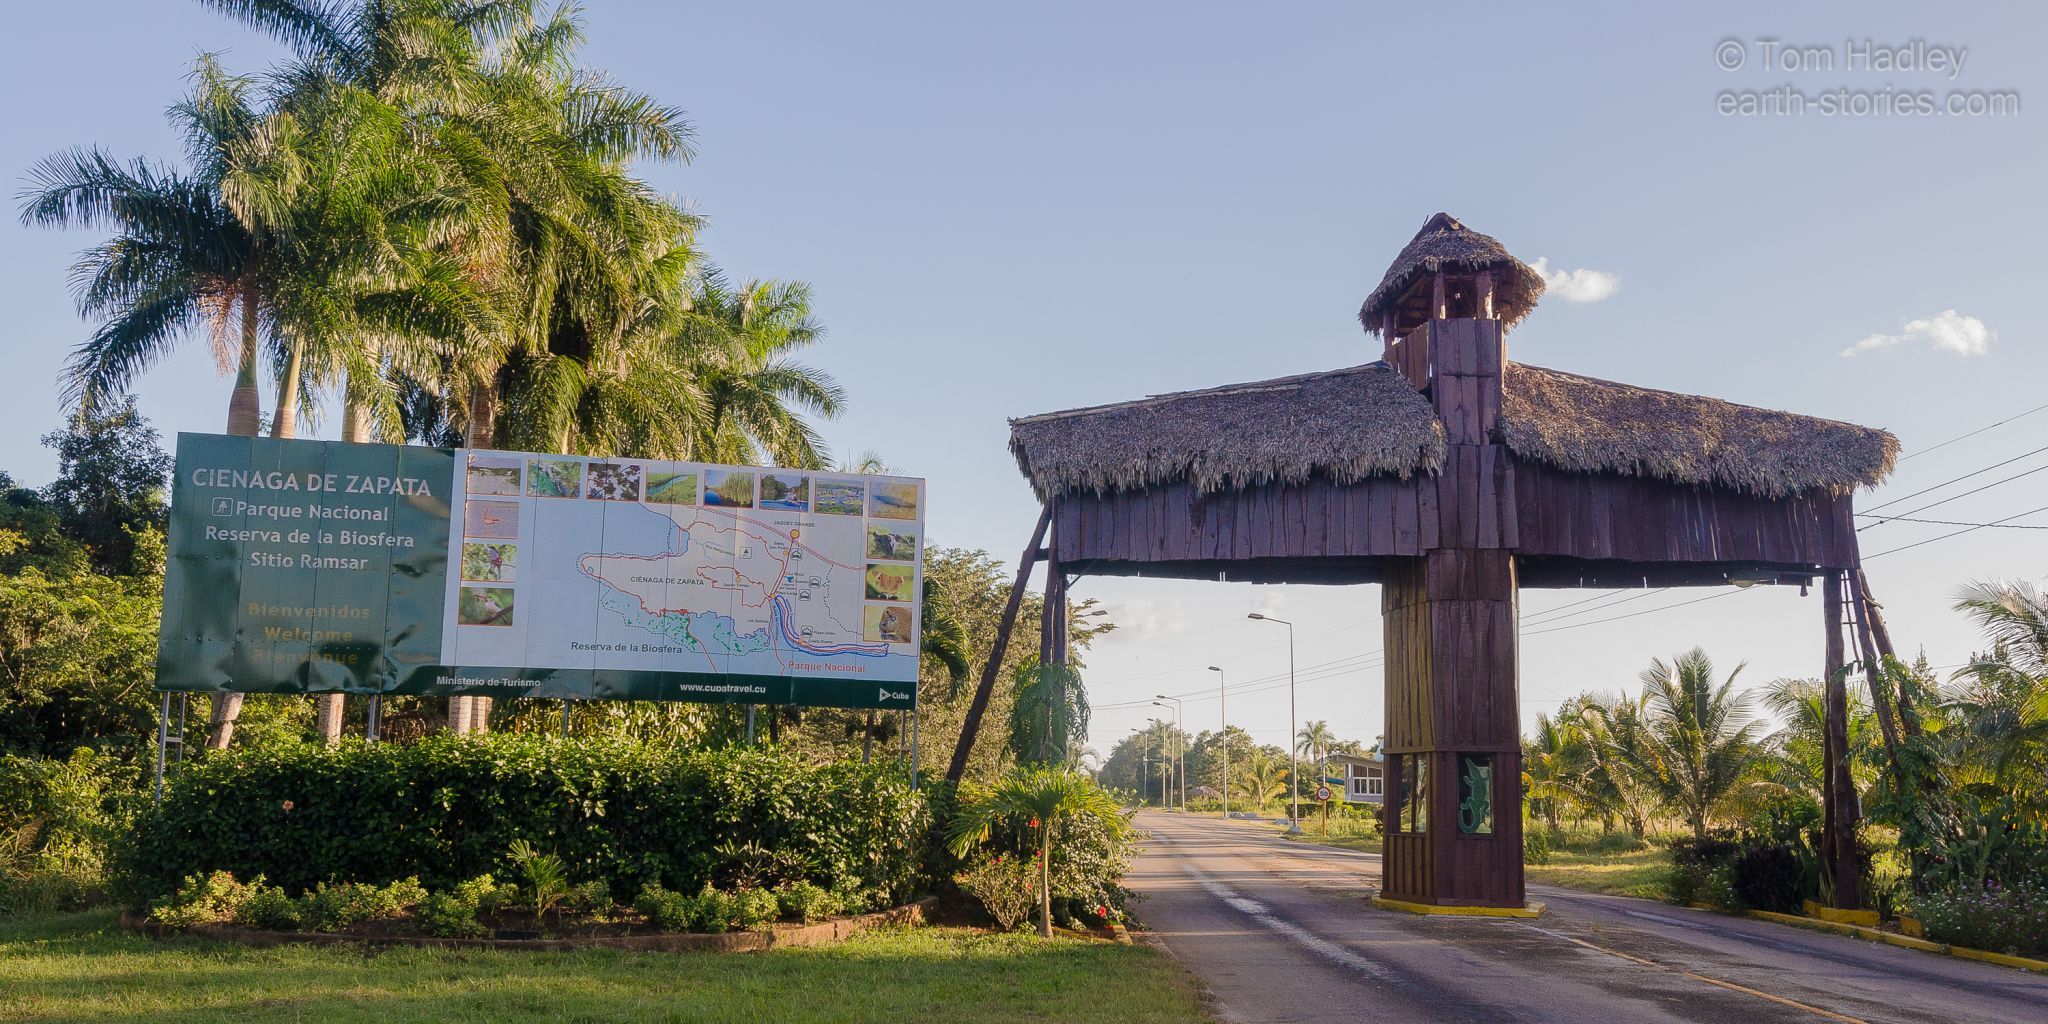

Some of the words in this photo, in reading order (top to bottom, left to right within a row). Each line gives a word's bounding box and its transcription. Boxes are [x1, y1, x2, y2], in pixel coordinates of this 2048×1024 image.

[192, 467, 299, 491] CIENAGA
[307, 474, 337, 492] DE
[345, 475, 431, 497] ZAPATA
[236, 501, 302, 520] Parque
[309, 504, 388, 521] Nacional
[205, 525, 281, 544] Reserva
[287, 527, 311, 544] de
[318, 529, 333, 545] la
[340, 530, 414, 548] Biosfera
[250, 551, 294, 569] Sitio
[300, 553, 369, 571] Ramsar
[677, 578, 705, 586] ZAPATA
[247, 601, 370, 618] Bienvenidos
[264, 626, 353, 641] Welcome
[571, 641, 612, 651] Reserva
[614, 643, 627, 652] de
[630, 644, 639, 652] la
[641, 643, 683, 653] Biosfera
[788, 660, 822, 671] Parque
[824, 663, 866, 673] Nacional
[436, 675, 485, 687] Ministerio
[487, 677, 500, 687] de
[502, 677, 541, 688] Turismo
[891, 691, 910, 700] Cuba
